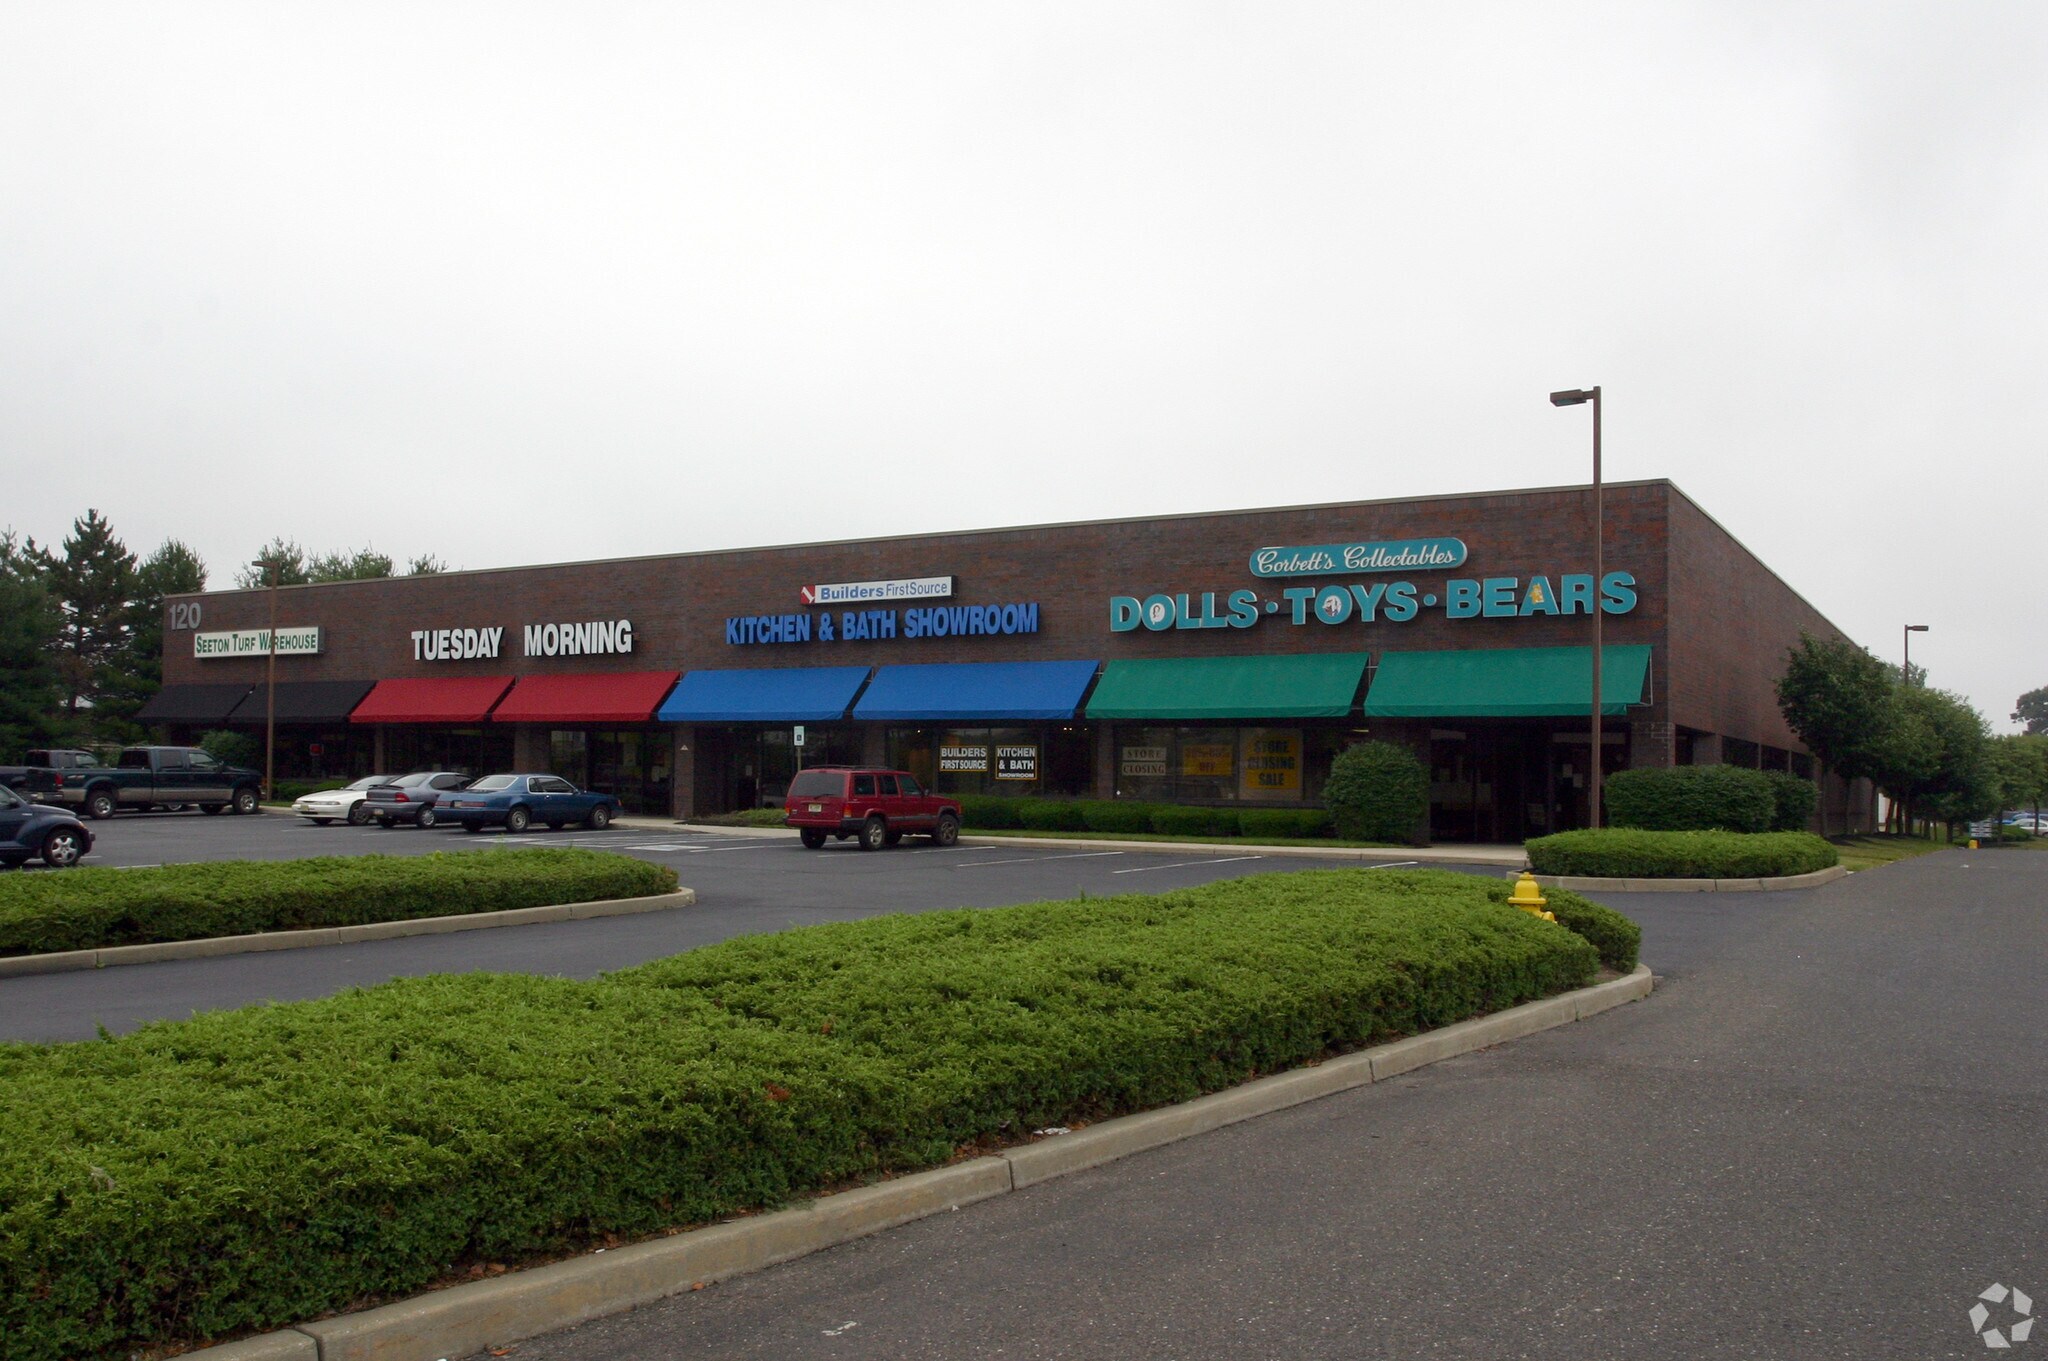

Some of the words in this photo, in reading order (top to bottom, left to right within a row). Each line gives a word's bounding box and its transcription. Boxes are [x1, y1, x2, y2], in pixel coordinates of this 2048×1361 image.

[1257, 550, 1336, 574] Corbett's
[1343, 544, 1456, 569] Collectables
[821, 586, 884, 600] Builders
[885, 580, 947, 596] FirstSource
[1110, 589, 1259, 633] DOLLS
[1283, 581, 1418, 626] TOYS
[1446, 570, 1638, 618] BEARS
[169, 602, 201, 631] 120
[726, 613, 811, 645] KITCHEN
[818, 612, 834, 642] &
[842, 609, 898, 641] BATH
[904, 602, 1040, 639] SHOWROOM
[196, 635, 230, 654] SEETON
[232, 633, 256, 652] TURF
[411, 626, 503, 661] TUESDAY
[524, 619, 632, 657] MORNING
[941, 748, 987, 757] BUILDERS
[997, 748, 1036, 757] KITCHEN
[999, 760, 1006, 770] &
[1010, 760, 1035, 770] BATH
[1122, 763, 1165, 774] CLOSING
[1258, 773, 1285, 786] SALE
